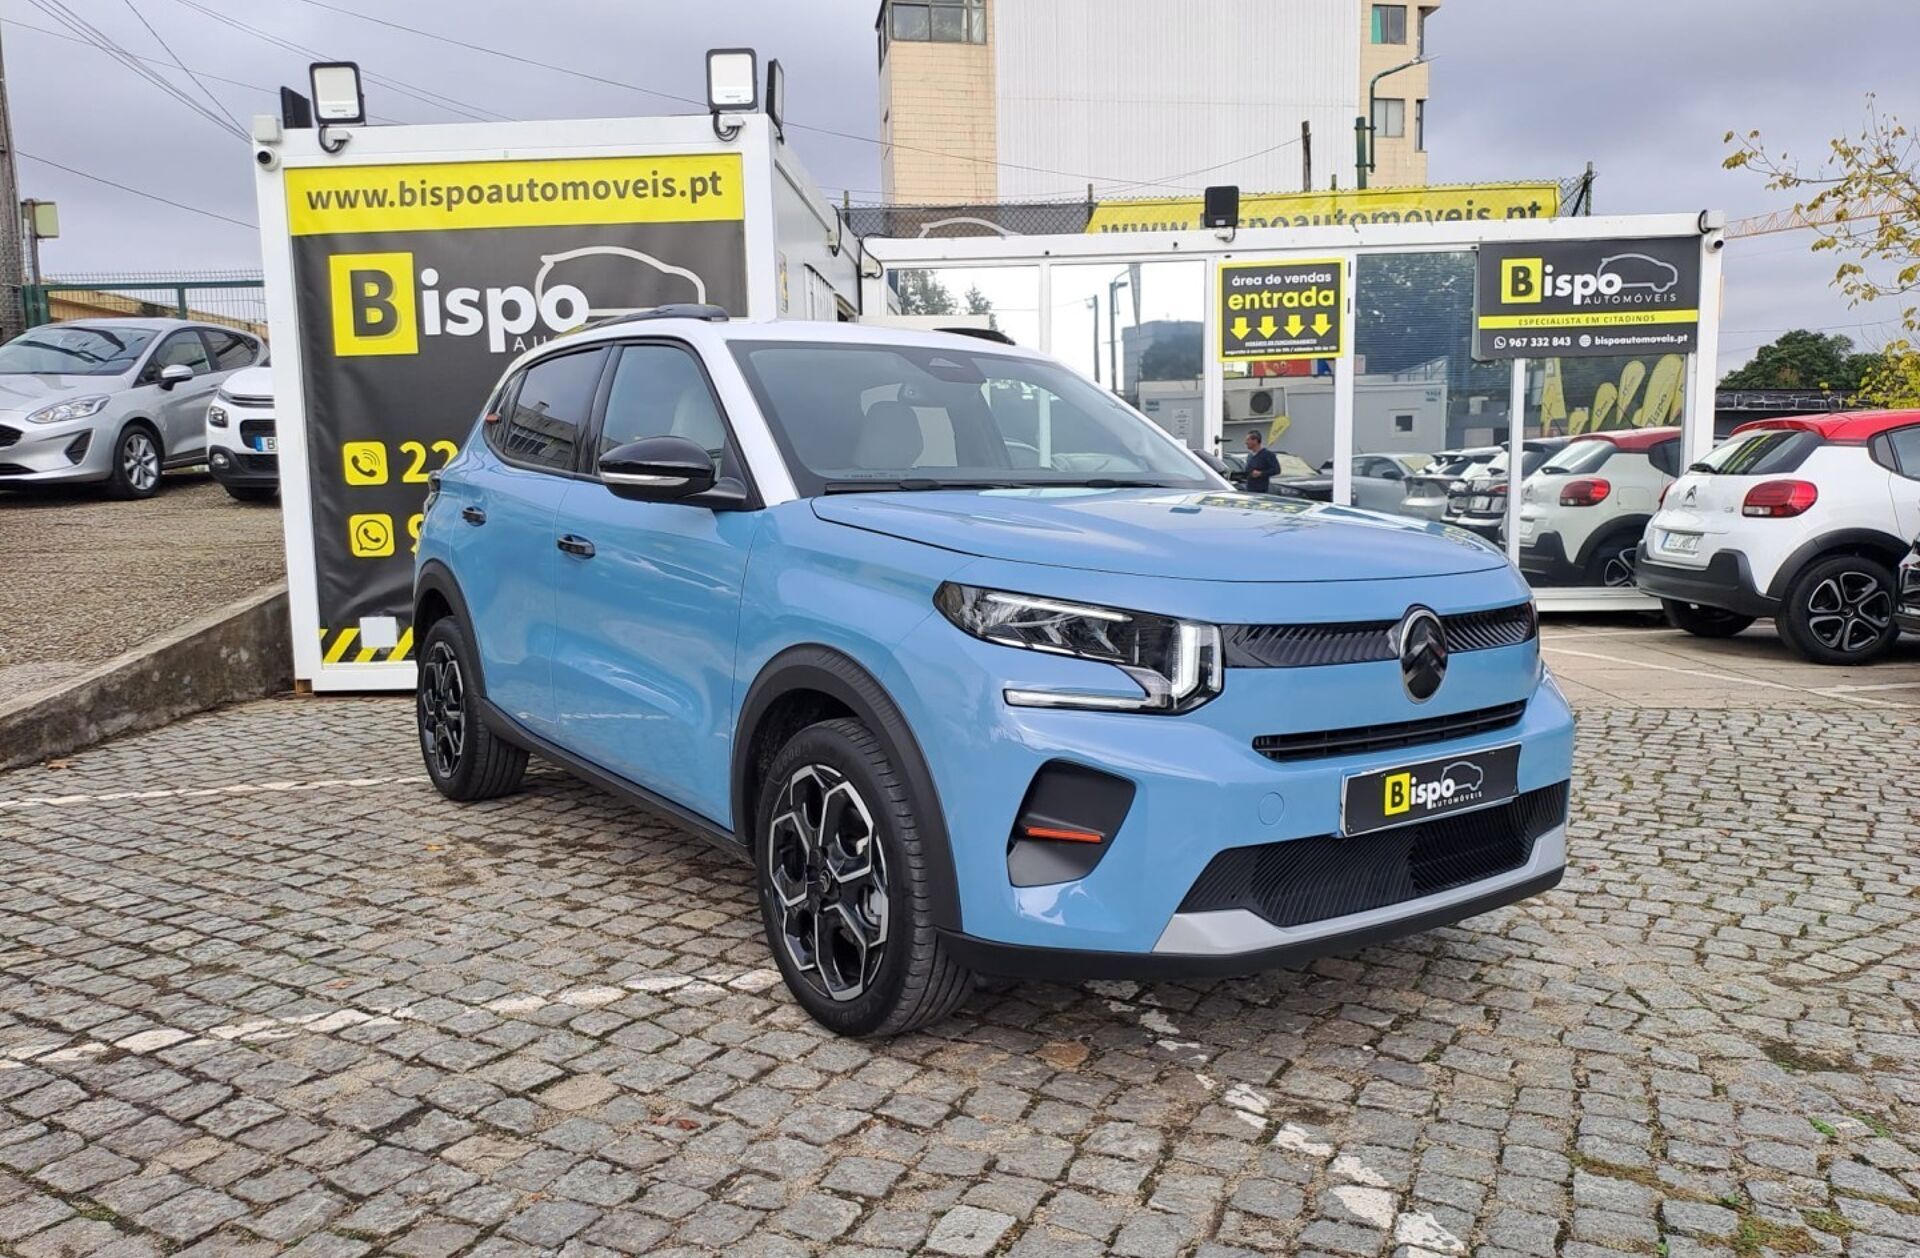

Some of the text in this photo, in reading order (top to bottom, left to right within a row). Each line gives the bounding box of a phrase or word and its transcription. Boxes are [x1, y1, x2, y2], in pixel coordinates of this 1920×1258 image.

[307, 170, 722, 211] www.bispoautomoveis.pt
[1231, 271, 1332, 286] área de vendas
[1511, 264, 1622, 305] Bispo
[350, 267, 590, 353] Bispo
[1228, 285, 1335, 310] entrada
[1584, 292, 1677, 305] AUTOMÓVEIS
[1518, 314, 1656, 326] ESPECIALISTA EM CITADINOS
[1508, 337, 1528, 348] 967
[1530, 336, 1549, 347] 332
[1552, 335, 1572, 346] 843
[1391, 777, 1456, 809] Bispo
